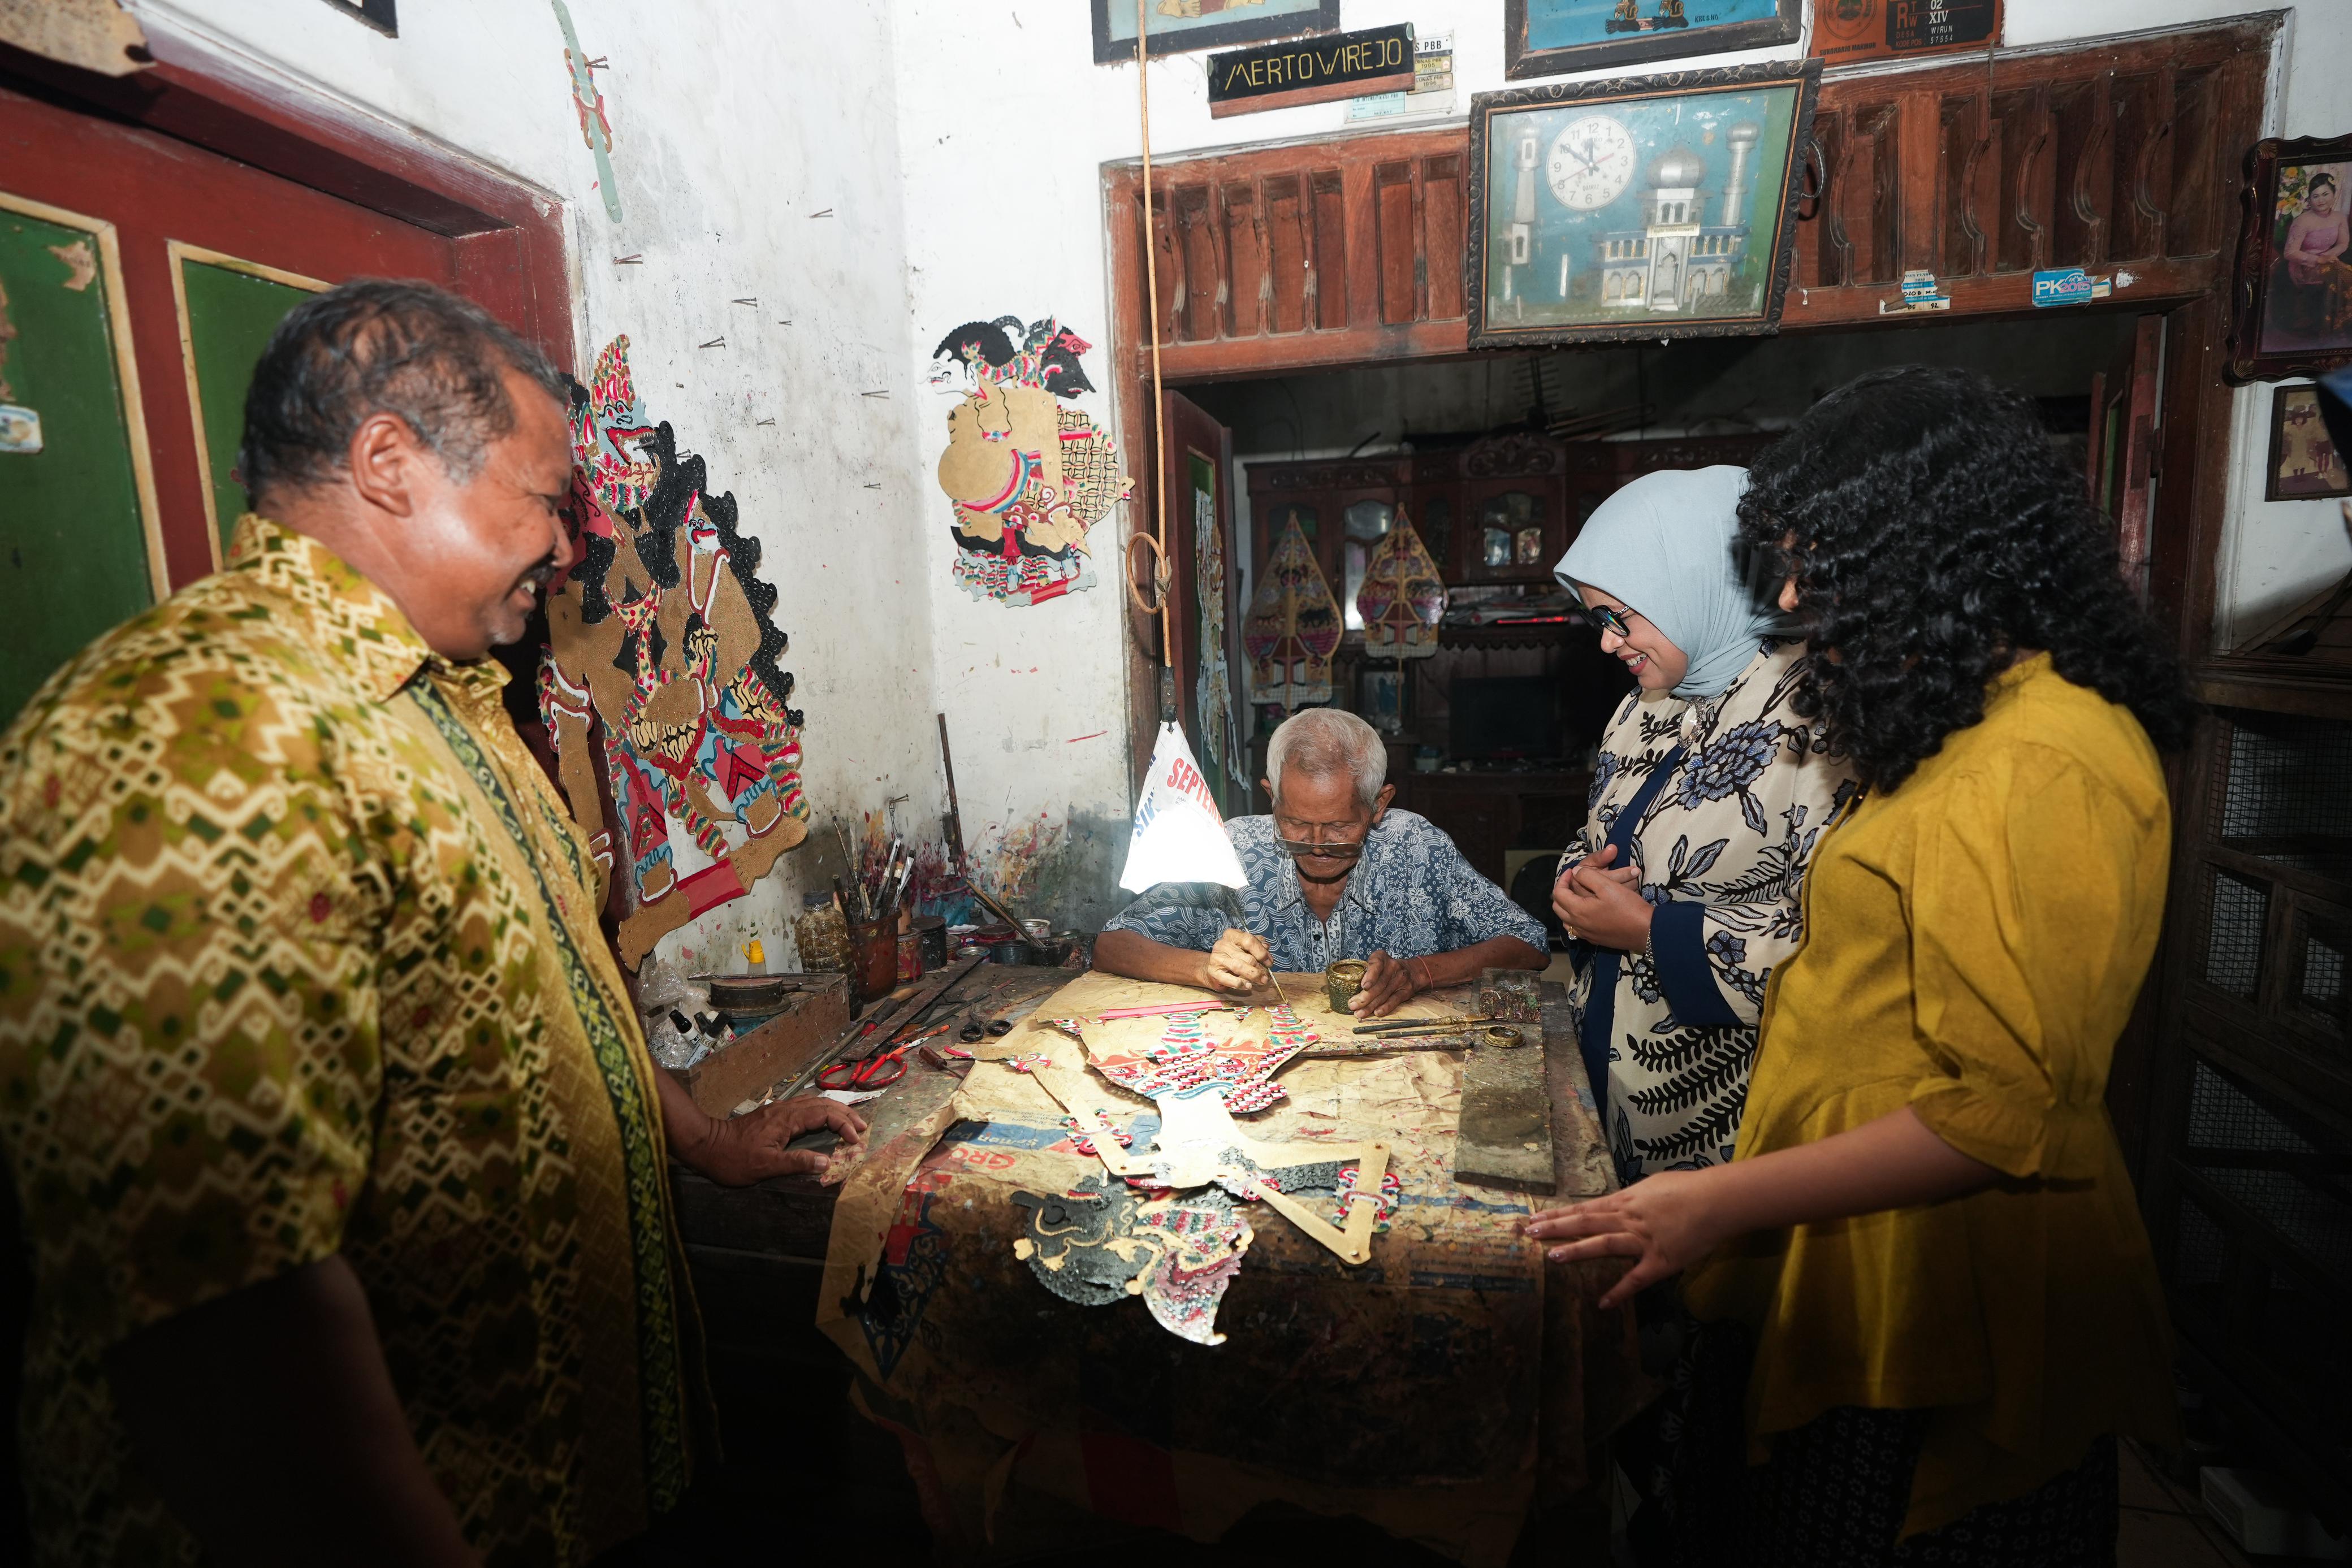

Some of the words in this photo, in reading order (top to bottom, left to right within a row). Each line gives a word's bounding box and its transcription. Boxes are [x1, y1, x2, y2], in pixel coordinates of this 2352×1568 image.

[1930, 0, 1943, 10] 02
[1929, 10, 1949, 24] XIV
[1896, 31, 1914, 39] DESA
[1931, 25, 1953, 34] WIRUN
[1930, 34, 1953, 44] 57554
[1424, 40, 1441, 50] PBB
[1587, 123, 1599, 133] 12
[1606, 127, 1611, 136] 1
[1571, 129, 1580, 140] 11
[1618, 138, 1624, 149] 2
[1621, 156, 1628, 167] 3
[1554, 162, 1562, 172] 9
[1615, 175, 1623, 184] 4
[1558, 180, 1565, 190] 8
[1570, 190, 1576, 201] 7
[1603, 188, 1610, 198] 5
[1585, 194, 1593, 204] 6
